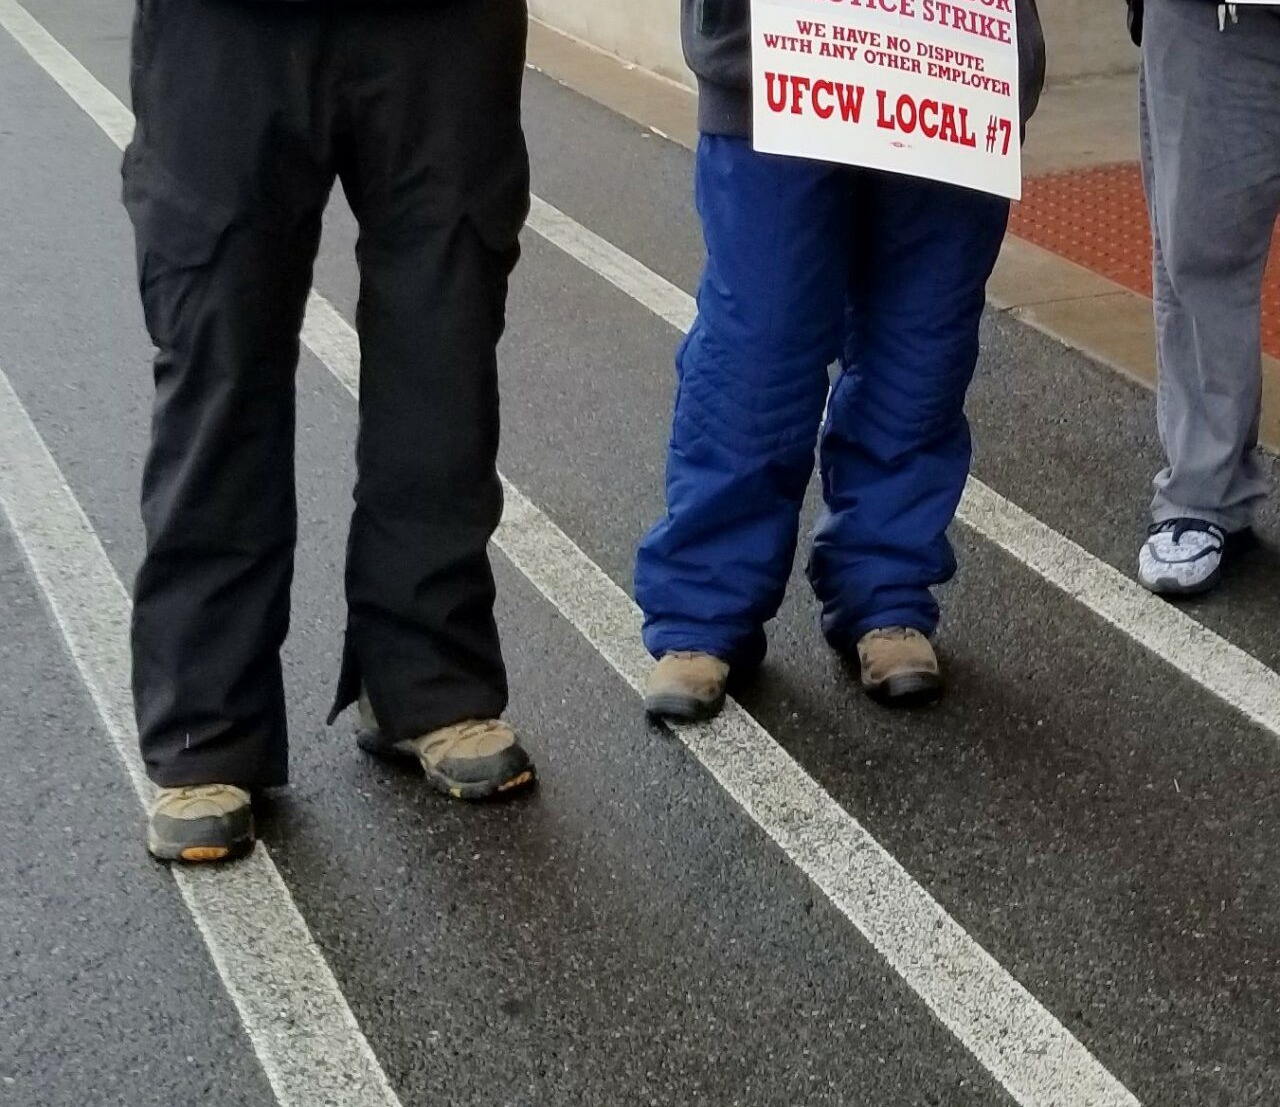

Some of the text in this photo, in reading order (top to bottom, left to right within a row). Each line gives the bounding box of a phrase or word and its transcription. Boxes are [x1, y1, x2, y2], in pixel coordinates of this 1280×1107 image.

[797, 21, 985, 72] WE HAVE NO DISPUTE
[922, 0, 1012, 44] STRIKE
[763, 33, 1011, 97] WITH ANY OTHER EMPLOYER
[765, 72, 1012, 156] UFCW LOCAL #7
